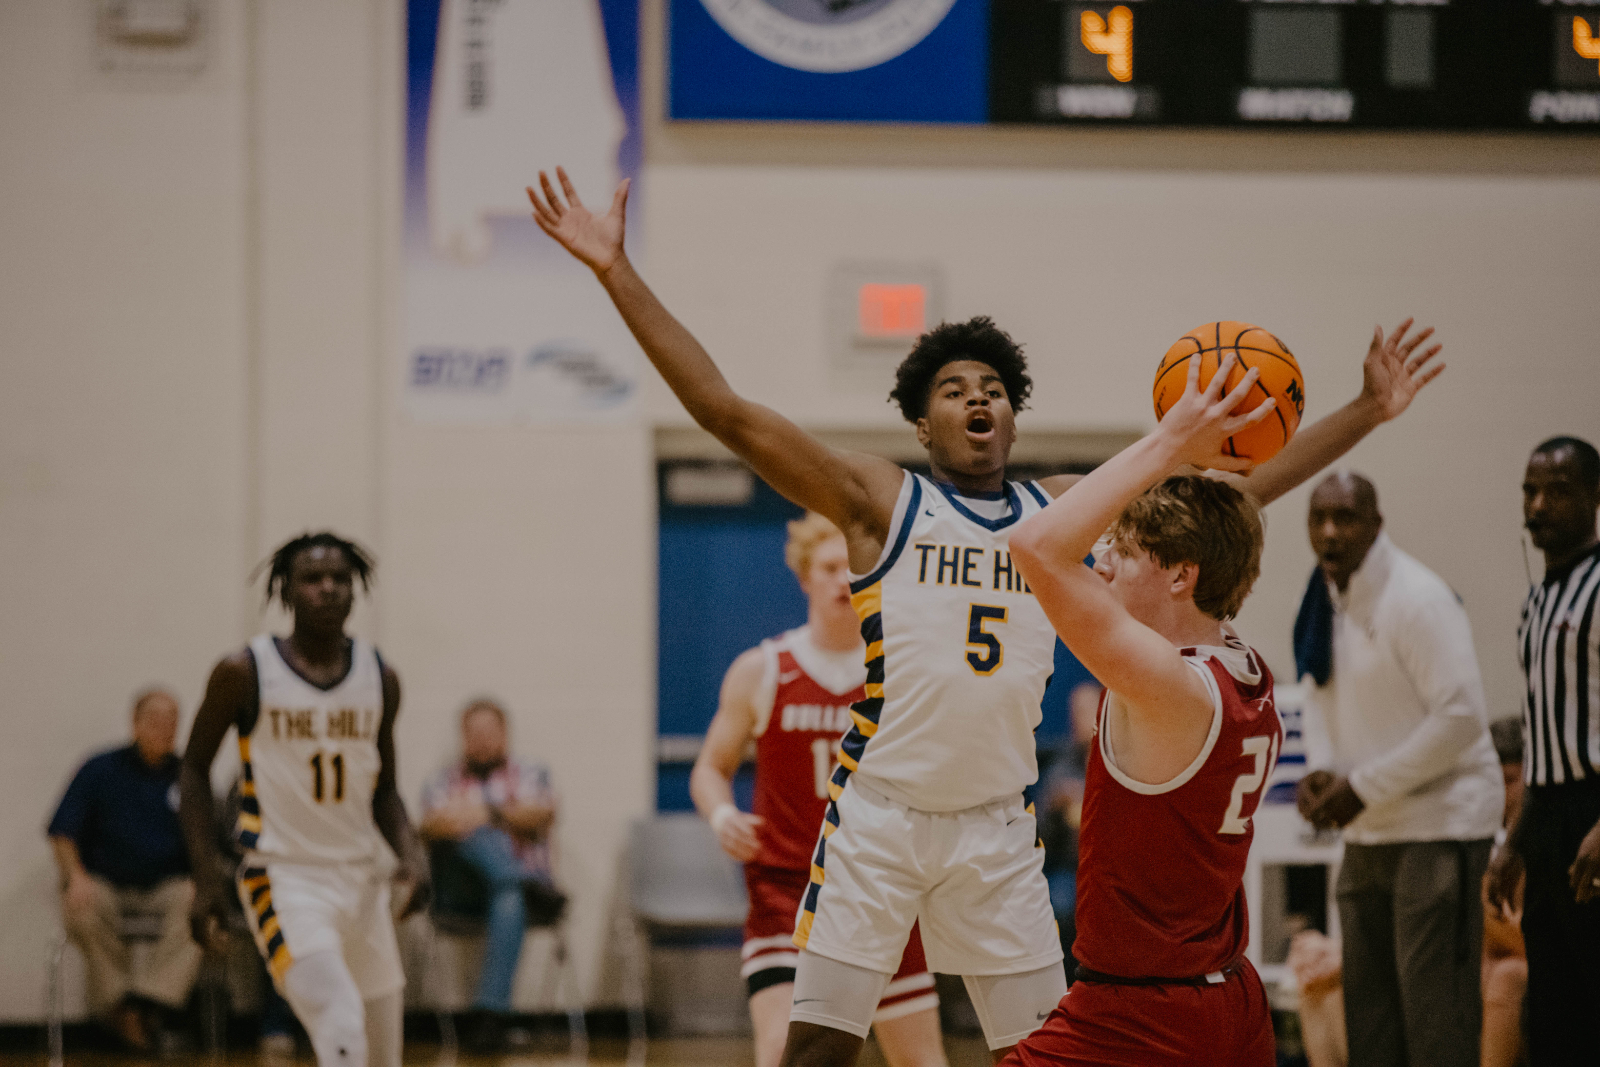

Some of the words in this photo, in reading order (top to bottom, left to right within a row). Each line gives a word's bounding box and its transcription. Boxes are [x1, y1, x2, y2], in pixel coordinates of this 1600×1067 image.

[1081, 5, 1133, 82] 4
[914, 543, 985, 589] THE
[964, 602, 1009, 676] 5
[269, 708, 317, 740] THE
[310, 751, 345, 804] 11
